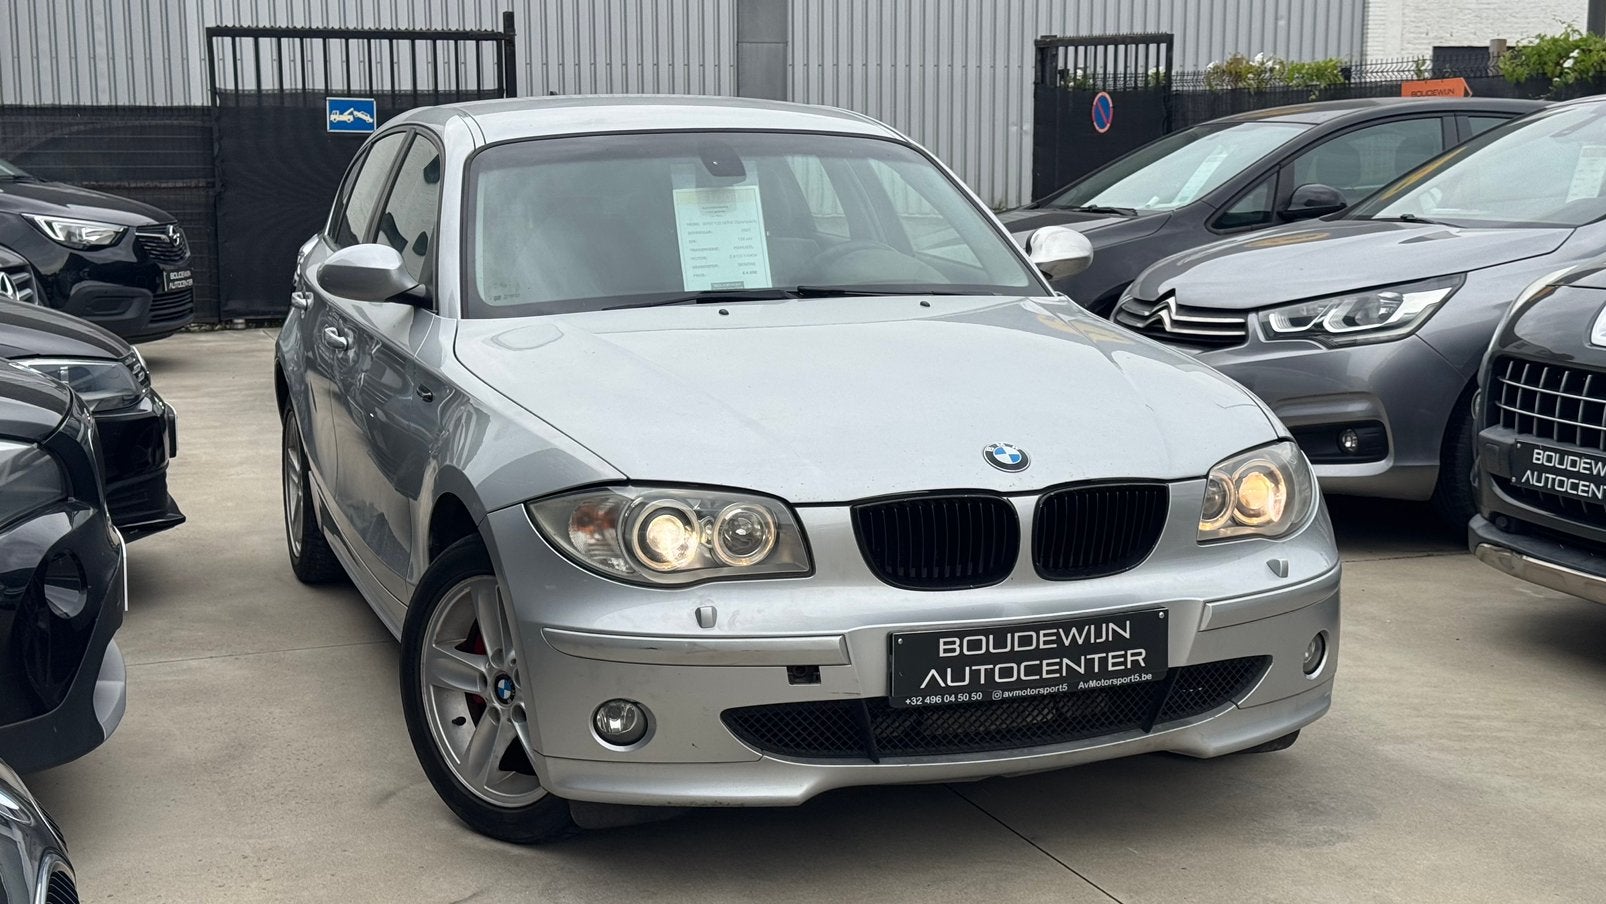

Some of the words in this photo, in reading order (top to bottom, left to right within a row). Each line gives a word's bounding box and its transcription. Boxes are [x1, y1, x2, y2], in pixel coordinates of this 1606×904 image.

[939, 620, 1131, 657] BOUDEWIJN
[920, 648, 1146, 689] AUTOCENTER
[905, 697, 922, 705] +32
[924, 695, 942, 704] 496
[944, 694, 955, 703] 04
[958, 693, 969, 701] 50
[971, 692, 983, 700] 50
[1078, 673, 1153, 690] AvMotorsport5.be
